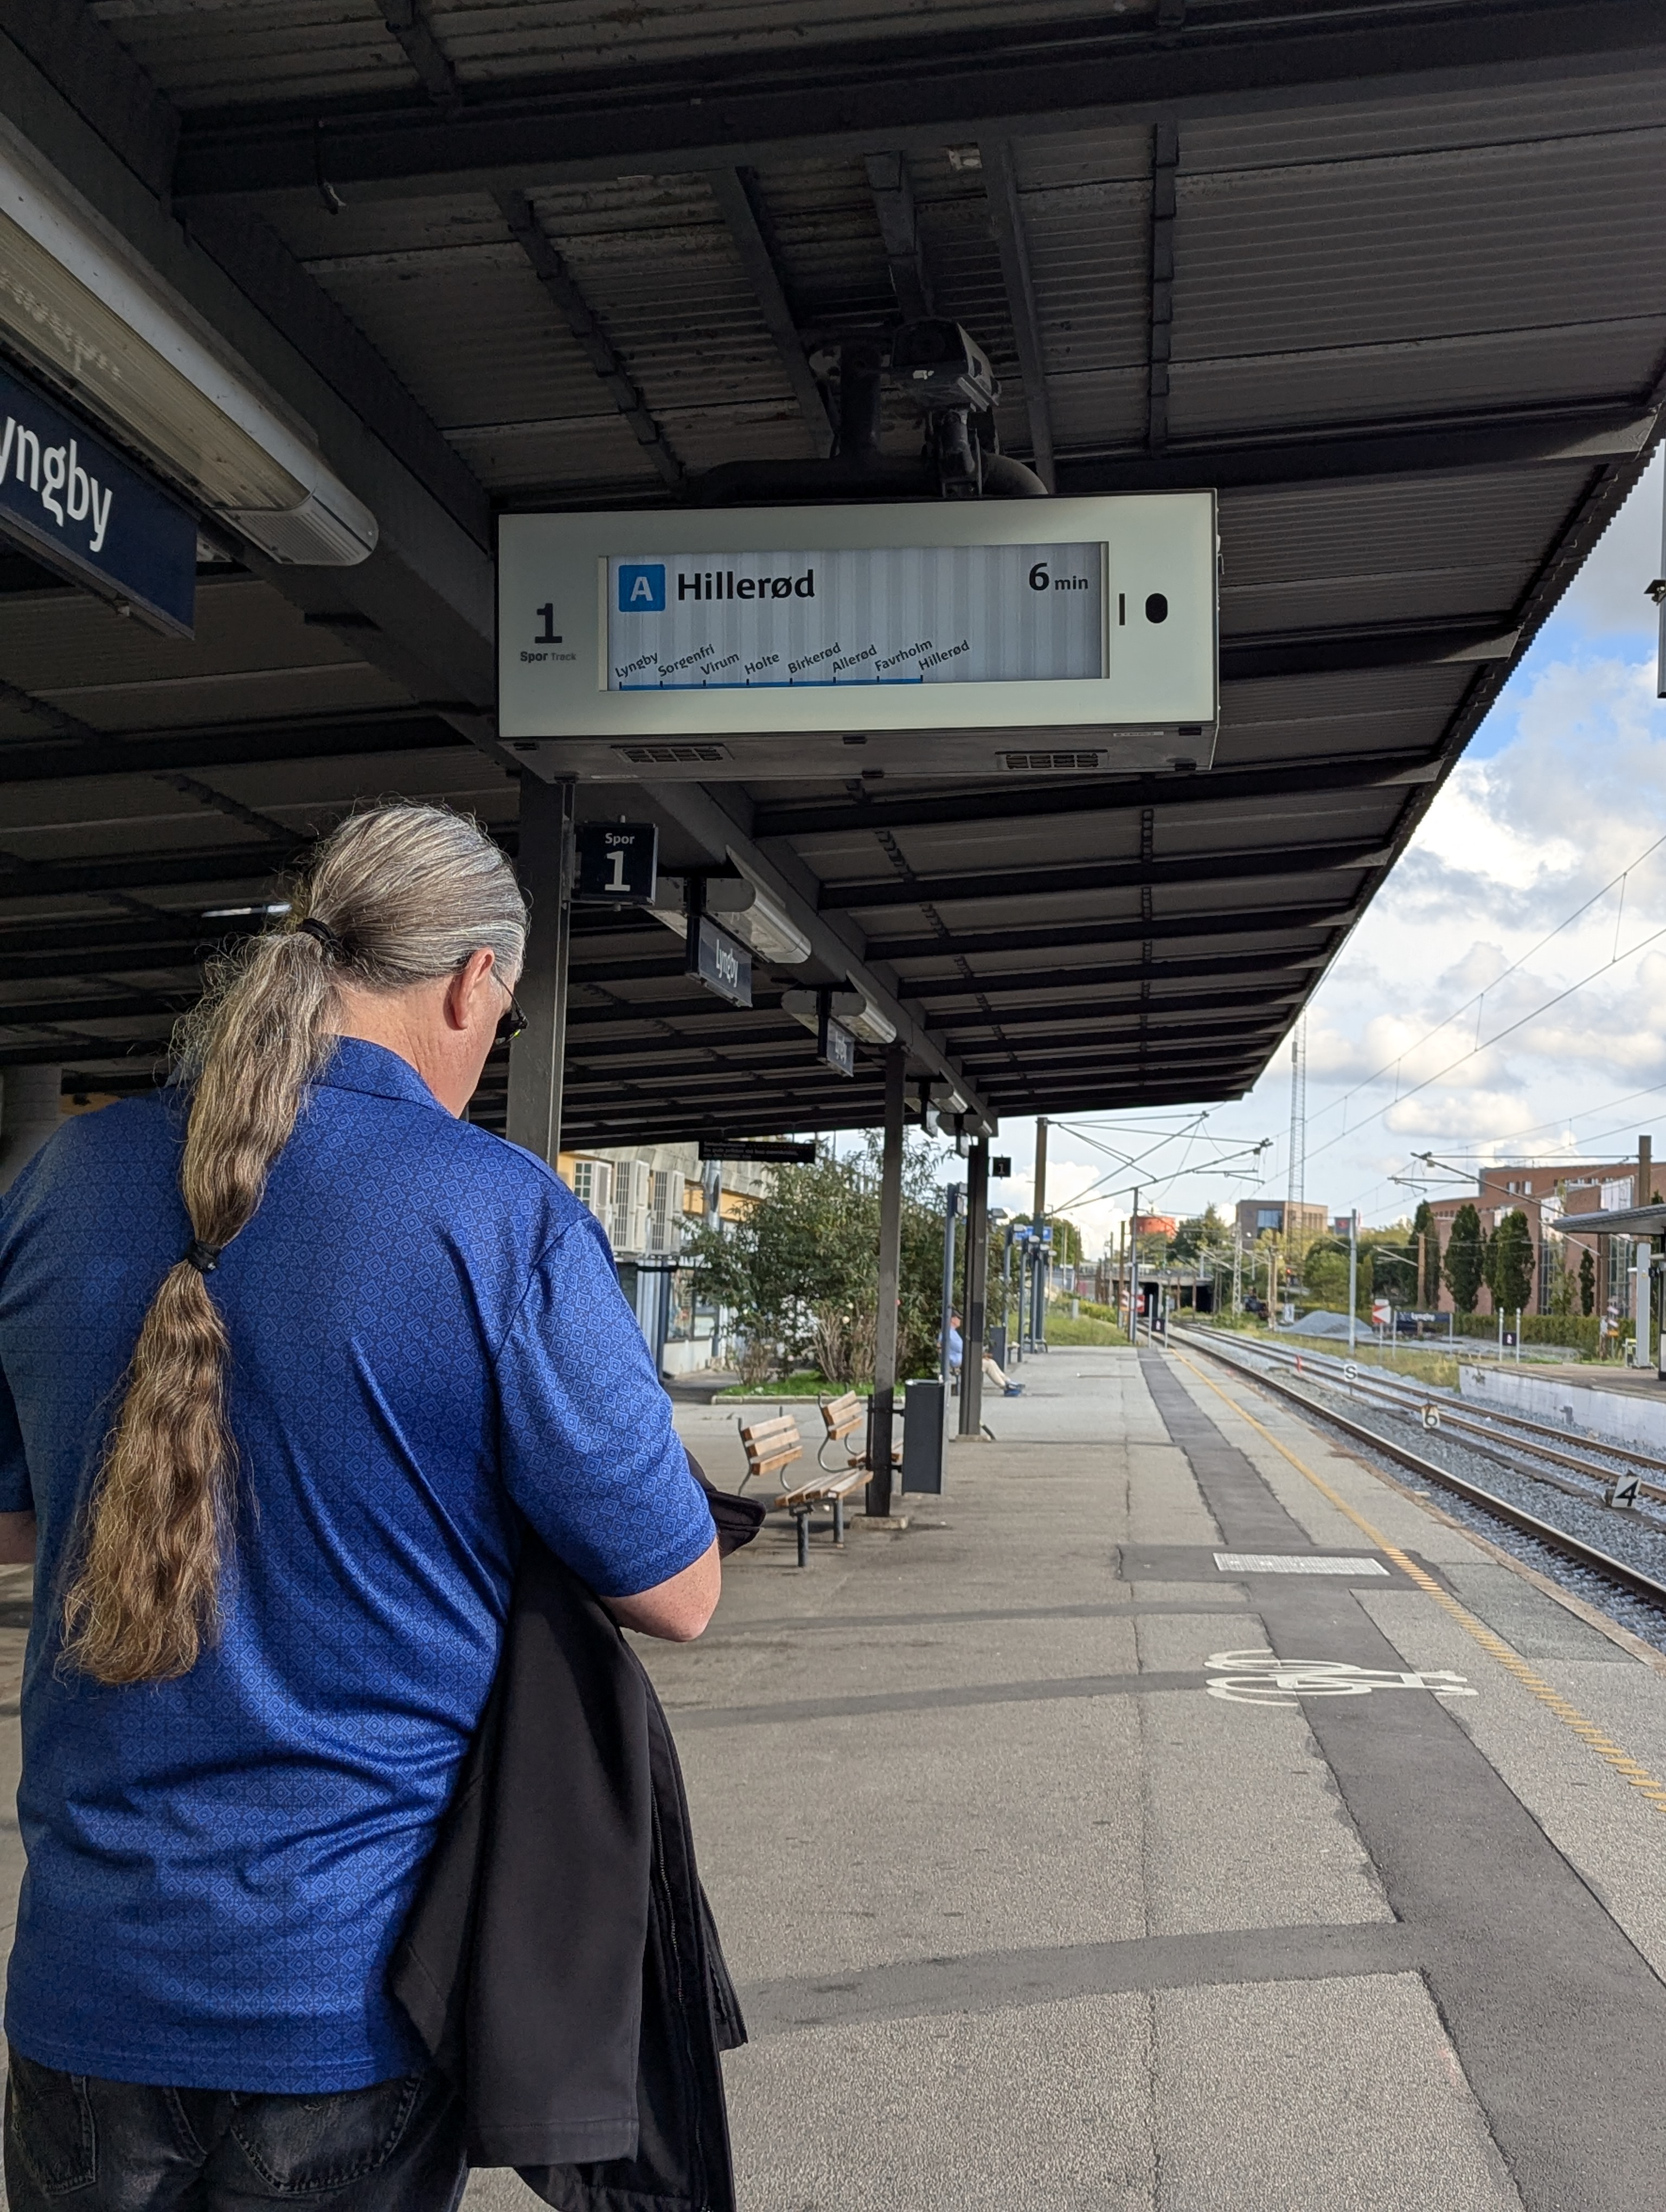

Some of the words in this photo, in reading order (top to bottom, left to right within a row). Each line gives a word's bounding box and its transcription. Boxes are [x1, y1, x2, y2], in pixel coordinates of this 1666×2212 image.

[630, 576, 653, 601] A
[678, 569, 815, 601] Hillerød
[1029, 562, 1049, 591] 6
[1055, 575, 1088, 590] min
[535, 603, 562, 644] 1
[520, 651, 548, 663] Spor
[551, 652, 576, 661] Track
[615, 652, 658, 678] Lyngby
[657, 644, 715, 677] Sorgenfri
[700, 653, 740, 675] Virum
[744, 653, 780, 674] Holte
[787, 642, 842, 674] Birkerød
[832, 644, 878, 673] Allerød
[874, 640, 933, 672] Favrholm
[918, 639, 971, 671] Hillerød
[605, 832, 635, 846] Spor
[604, 850, 631, 892] 1
[716, 938, 739, 988] Lyngby
[1345, 1365, 1357, 1379] S
[1425, 1406, 1438, 1426] 6
[1614, 1478, 1639, 1507] 4
